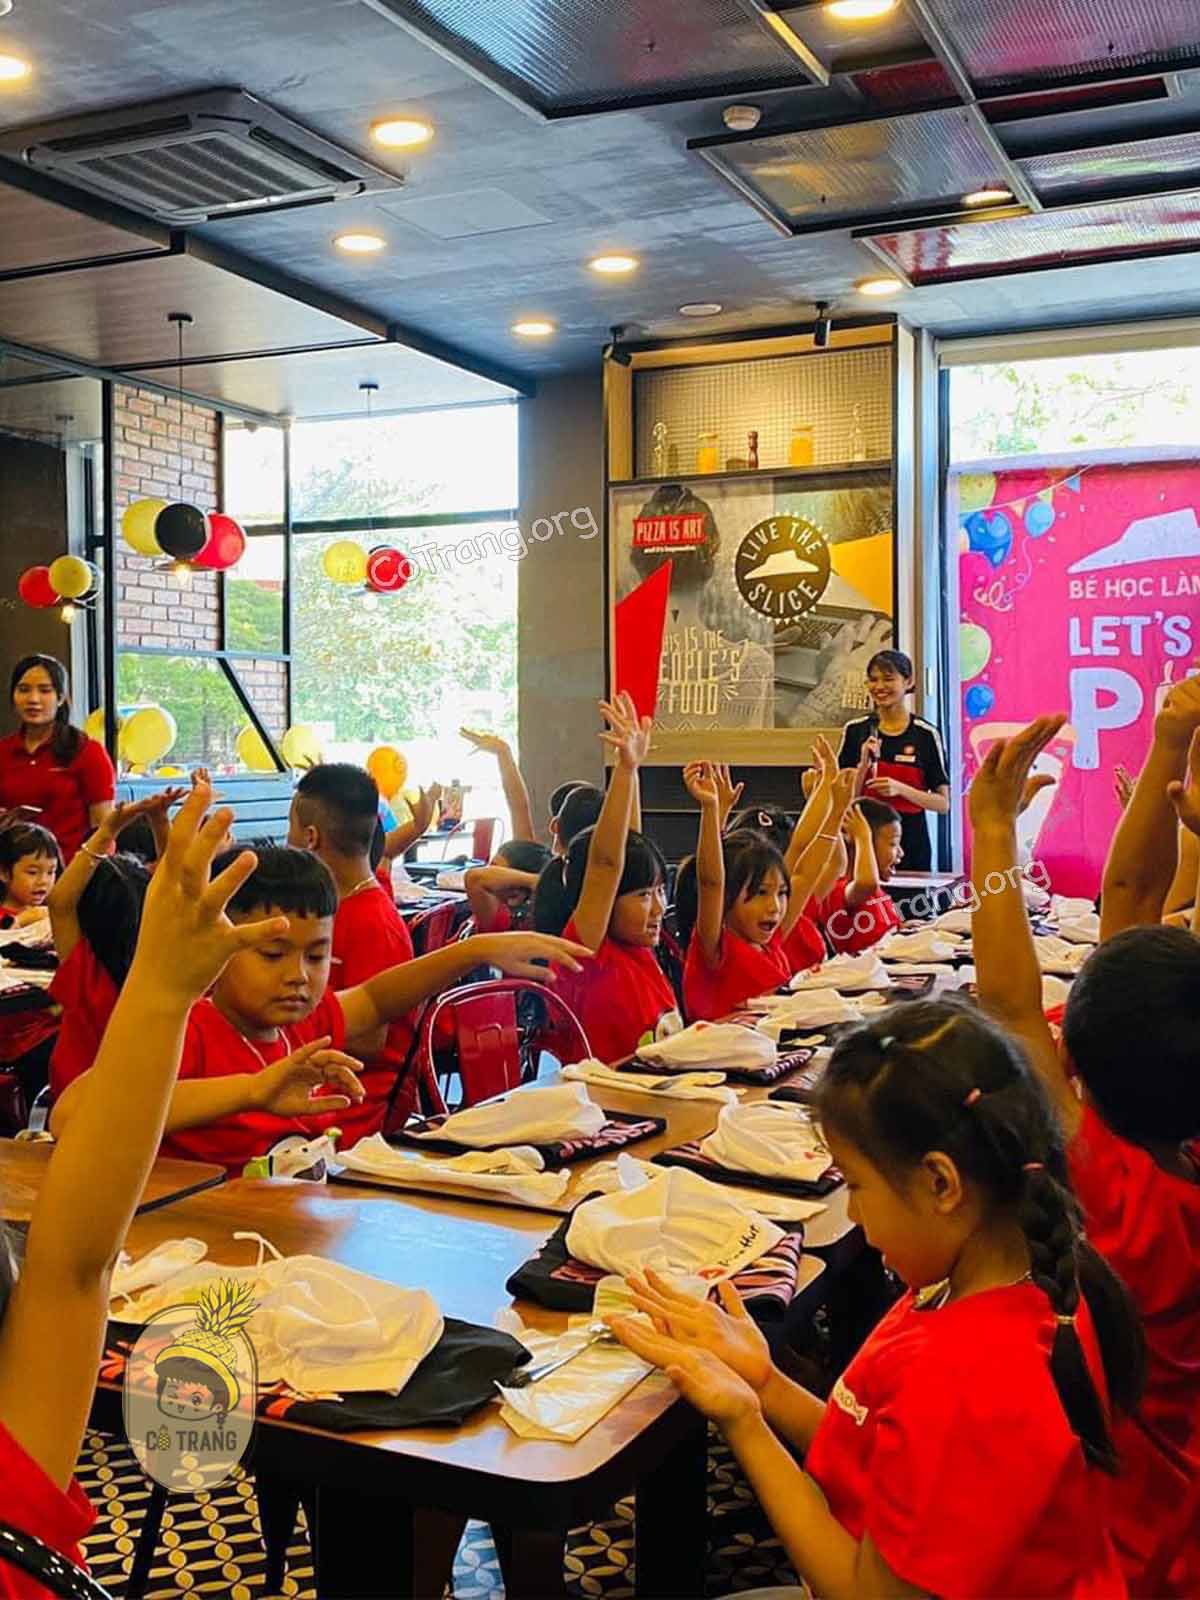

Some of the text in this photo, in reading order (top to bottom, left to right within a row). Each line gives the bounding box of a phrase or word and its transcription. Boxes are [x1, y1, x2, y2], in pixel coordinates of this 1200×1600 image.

[636, 518, 704, 542] PIZZA IS ART
[741, 522, 823, 561] LIVE THE
[748, 579, 819, 614] SLICE
[1069, 575, 1098, 600] BÉ
[1104, 577, 1153, 601] HỌC
[1069, 610, 1193, 657] LET'S
[660, 649, 741, 684] EOPLE'S
[668, 682, 719, 715] FOOD
